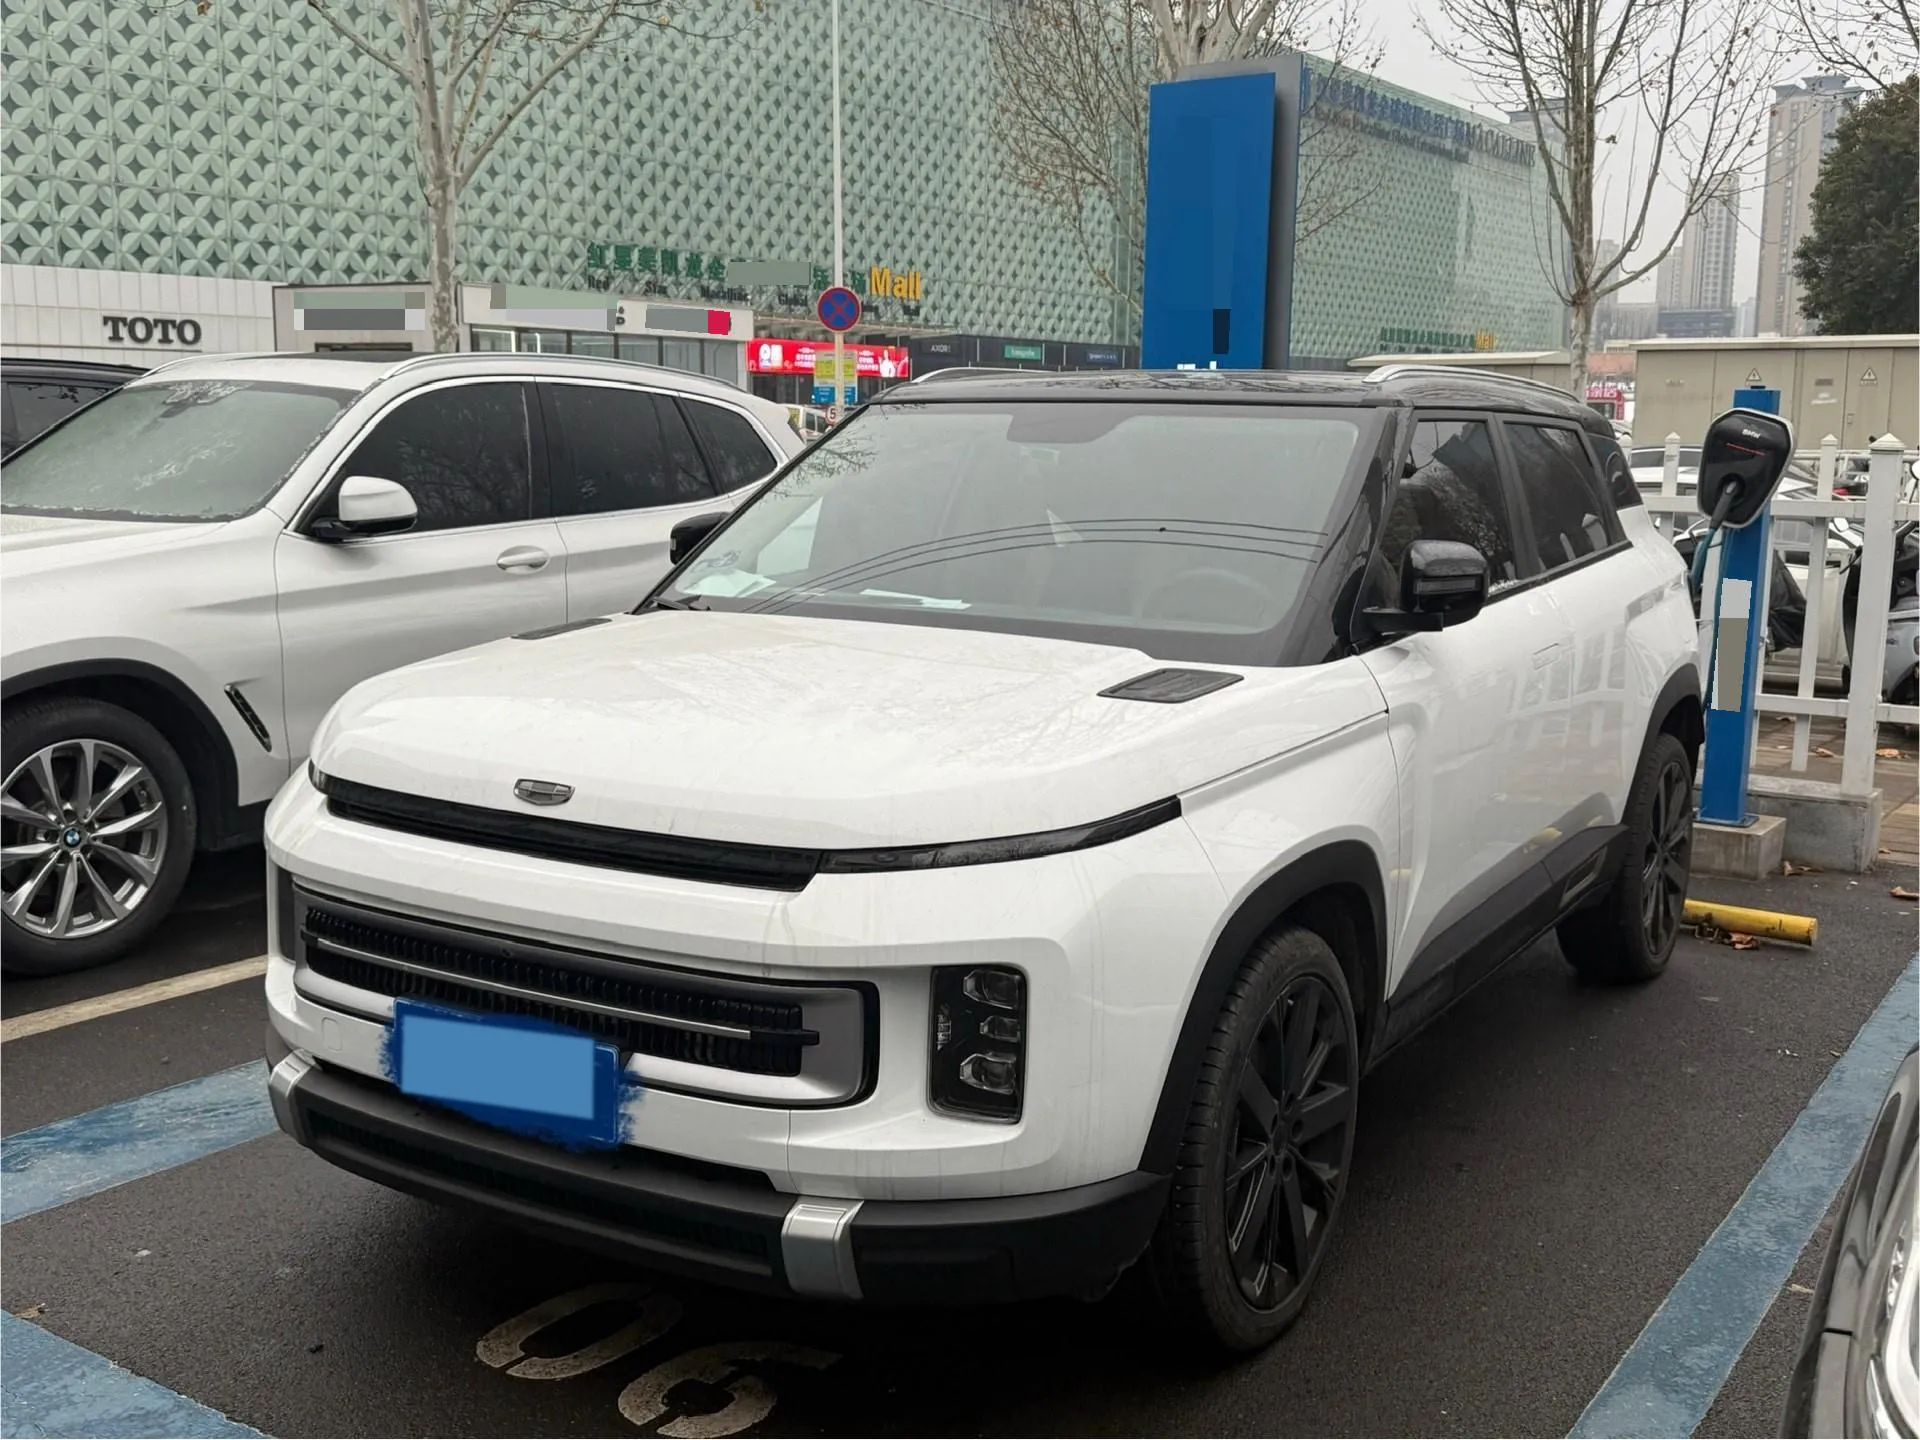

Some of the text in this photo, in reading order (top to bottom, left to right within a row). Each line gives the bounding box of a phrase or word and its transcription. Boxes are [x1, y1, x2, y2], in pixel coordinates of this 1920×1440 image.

[869, 264, 922, 300] Mall
[103, 315, 201, 345] TOTO
[476, 1281, 845, 1439] 06
